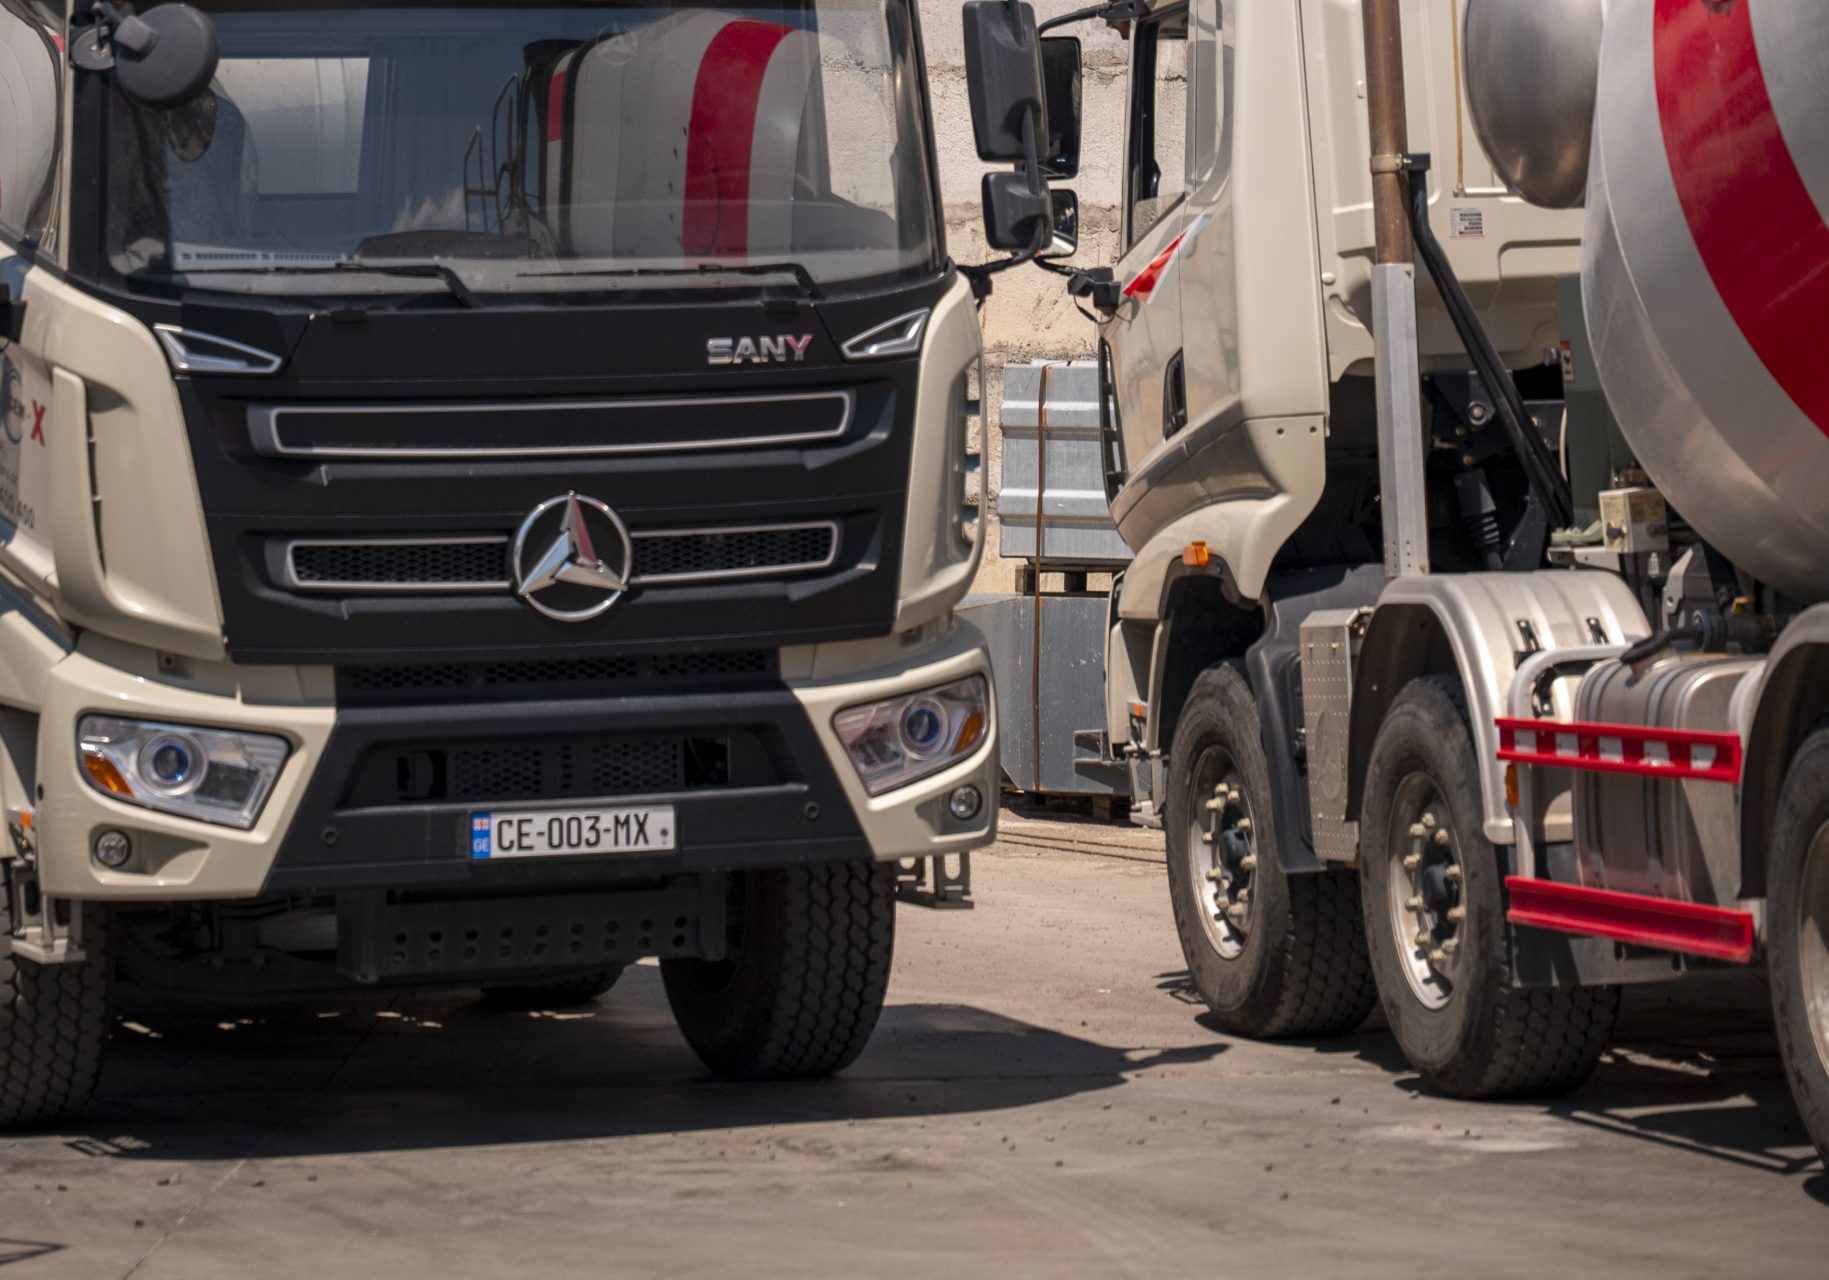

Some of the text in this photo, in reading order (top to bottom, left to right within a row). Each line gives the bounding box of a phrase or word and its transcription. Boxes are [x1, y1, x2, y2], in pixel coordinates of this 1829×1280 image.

[707, 334, 812, 365] SANY
[473, 837, 490, 853] GE
[497, 812, 650, 851] CE-003-MX
